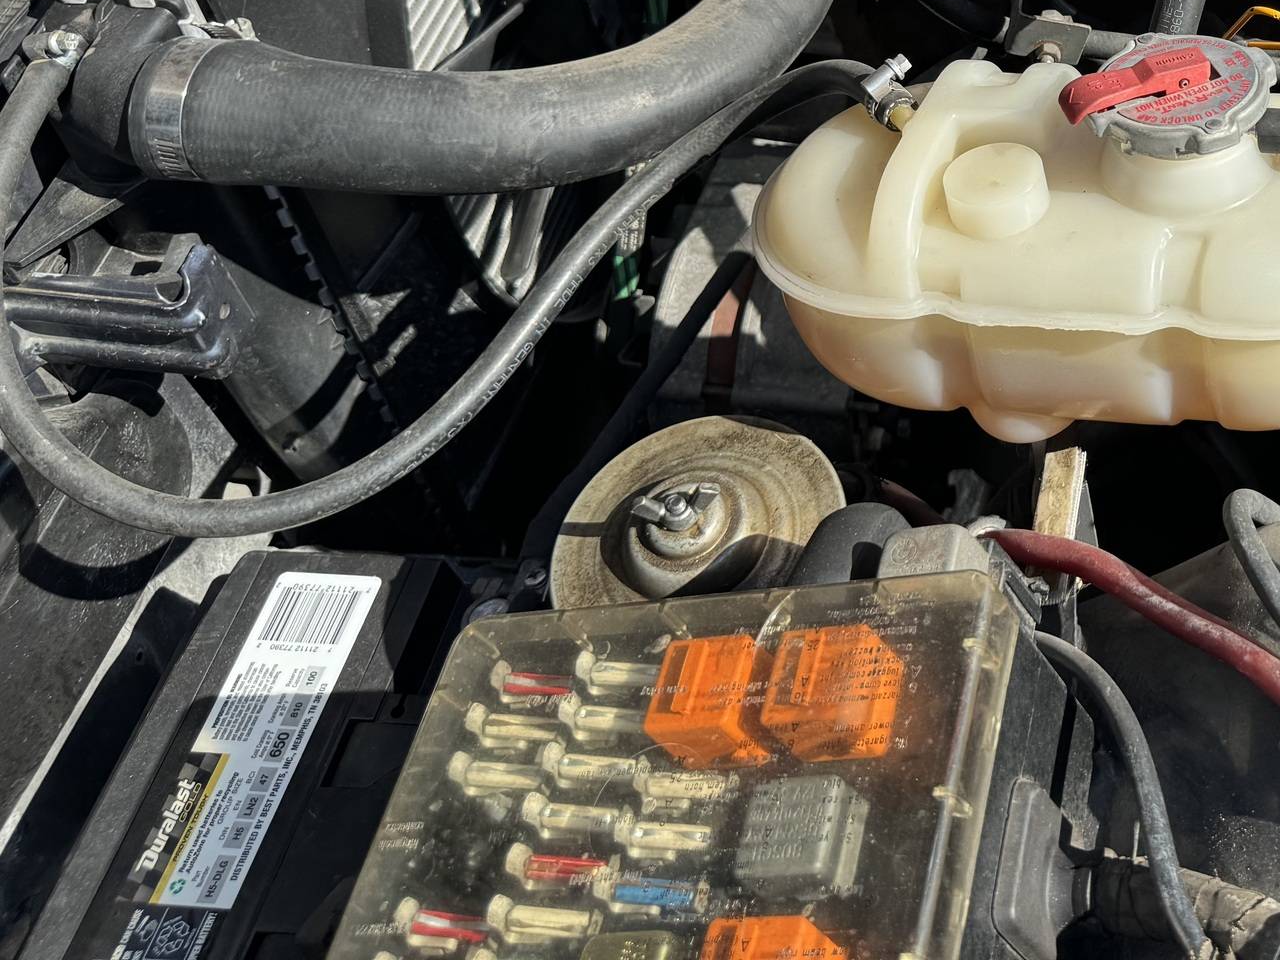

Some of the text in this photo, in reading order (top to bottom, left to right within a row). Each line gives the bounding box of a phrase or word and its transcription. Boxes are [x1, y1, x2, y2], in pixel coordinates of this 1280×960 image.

[1209, 77, 1228, 87] NOT
[1183, 85, 1207, 96] OPEN
[1134, 100, 1154, 112] HOT
[1155, 92, 1182, 105] WHEN
[1137, 114, 1156, 122] CAP
[1160, 113, 1202, 123] UNLOCK
[1204, 107, 1217, 117] TO
[552, 273, 586, 311] MADE
[292, 583, 321, 591] 77390
[326, 584, 354, 593] 21112
[270, 643, 292, 651] 77390
[294, 644, 318, 653] 21112
[305, 670, 318, 686] 100
[290, 701, 303, 718] 810
[269, 730, 290, 758] 650
[229, 683, 328, 881] DISTRIBUTED BY BEST PARTS, INC., MEMPHIS, TN 38103
[245, 769, 256, 783] BCI
[257, 773, 269, 785] 47
[177, 781, 202, 822] GOLD
[216, 776, 243, 824] GROUP SIZE
[232, 799, 242, 811] EN
[243, 795, 258, 816] LN2
[134, 776, 196, 870] Duralast
[184, 771, 239, 873] AutoZone for proper recycling
[177, 847, 194, 872] Return
[191, 829, 203, 847] used
[199, 797, 219, 828] batteries
[218, 825, 229, 840] DIN
[231, 825, 245, 840] H5
[172, 825, 194, 862] PROVEN
[204, 858, 229, 897] H5-DLG
[195, 911, 218, 943] BATTERY!
